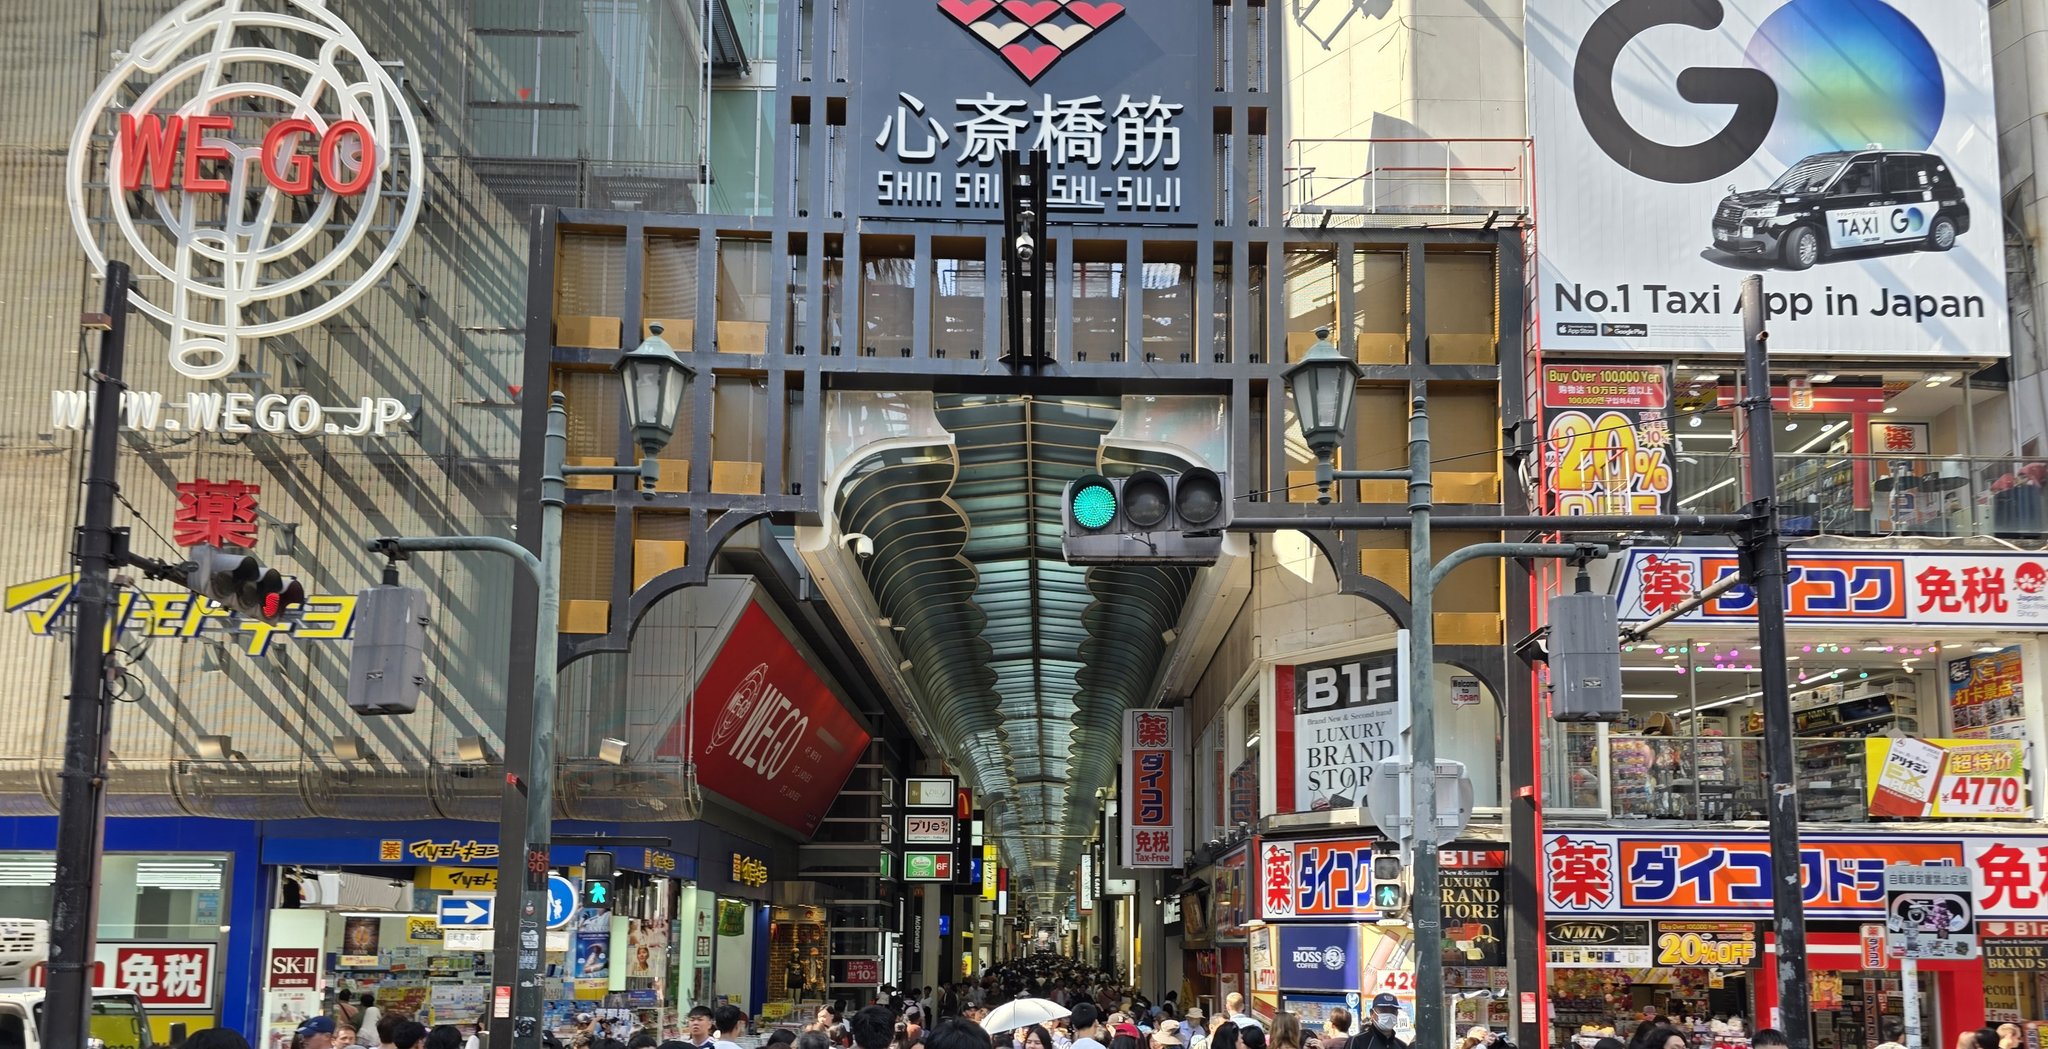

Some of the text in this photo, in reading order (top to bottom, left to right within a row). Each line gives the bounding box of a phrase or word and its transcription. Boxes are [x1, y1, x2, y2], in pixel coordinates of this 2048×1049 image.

[875, 92, 1184, 167] 心斎橋筋
[877, 170, 942, 204] SHIN
[1837, 207, 1924, 237] TAXI GO
[1555, 283, 1985, 323] No.1 Taxi pp in Japan
[1549, 370, 1661, 383] Buy Over 100,000 Yen
[1639, 412, 1661, 420] TAX
[1885, 426, 1915, 451] 薬
[1547, 410, 1673, 494] 20%
[174, 479, 260, 548] 薬
[1638, 554, 1695, 614] 薬
[1915, 565, 2008, 614] 免税
[1306, 662, 1392, 709] B1F
[1453, 680, 1478, 688] Welcome
[1453, 693, 1479, 702] Japan
[1307, 717, 1327, 726] Brand
[1351, 711, 1375, 719] Second
[1376, 708, 1393, 717] hand
[729, 683, 808, 781] WEGO
[1137, 713, 1169, 747] 薬
[1316, 721, 1386, 744] LUXURY
[1307, 740, 1394, 769] BRAND
[1891, 753, 1929, 774] アリナミン
[1951, 752, 2014, 774] 超特价
[1308, 765, 1374, 791] STOR
[1886, 763, 1926, 788] EX
[1140, 753, 1165, 824] ダイコク
[383, 841, 400, 859] 薬
[1135, 831, 1169, 852] 免税
[936, 862, 947, 870] 6F
[1136, 853, 1170, 862] Tax-Free
[1439, 850, 1487, 866] B1F
[1264, 844, 1295, 914] 薬
[1545, 835, 1614, 910] 薬
[1441, 889, 1500, 903] RAND
[1441, 904, 1499, 918] TORE
[1558, 925, 1607, 939] NMN
[1293, 951, 1322, 962] BOSS
[1986, 946, 2043, 957] LUXURY
[272, 956, 317, 974] SK-II
[1988, 958, 2035, 969] BRAND
[121, 953, 203, 998] 免税
[1984, 983, 2024, 996] econd
